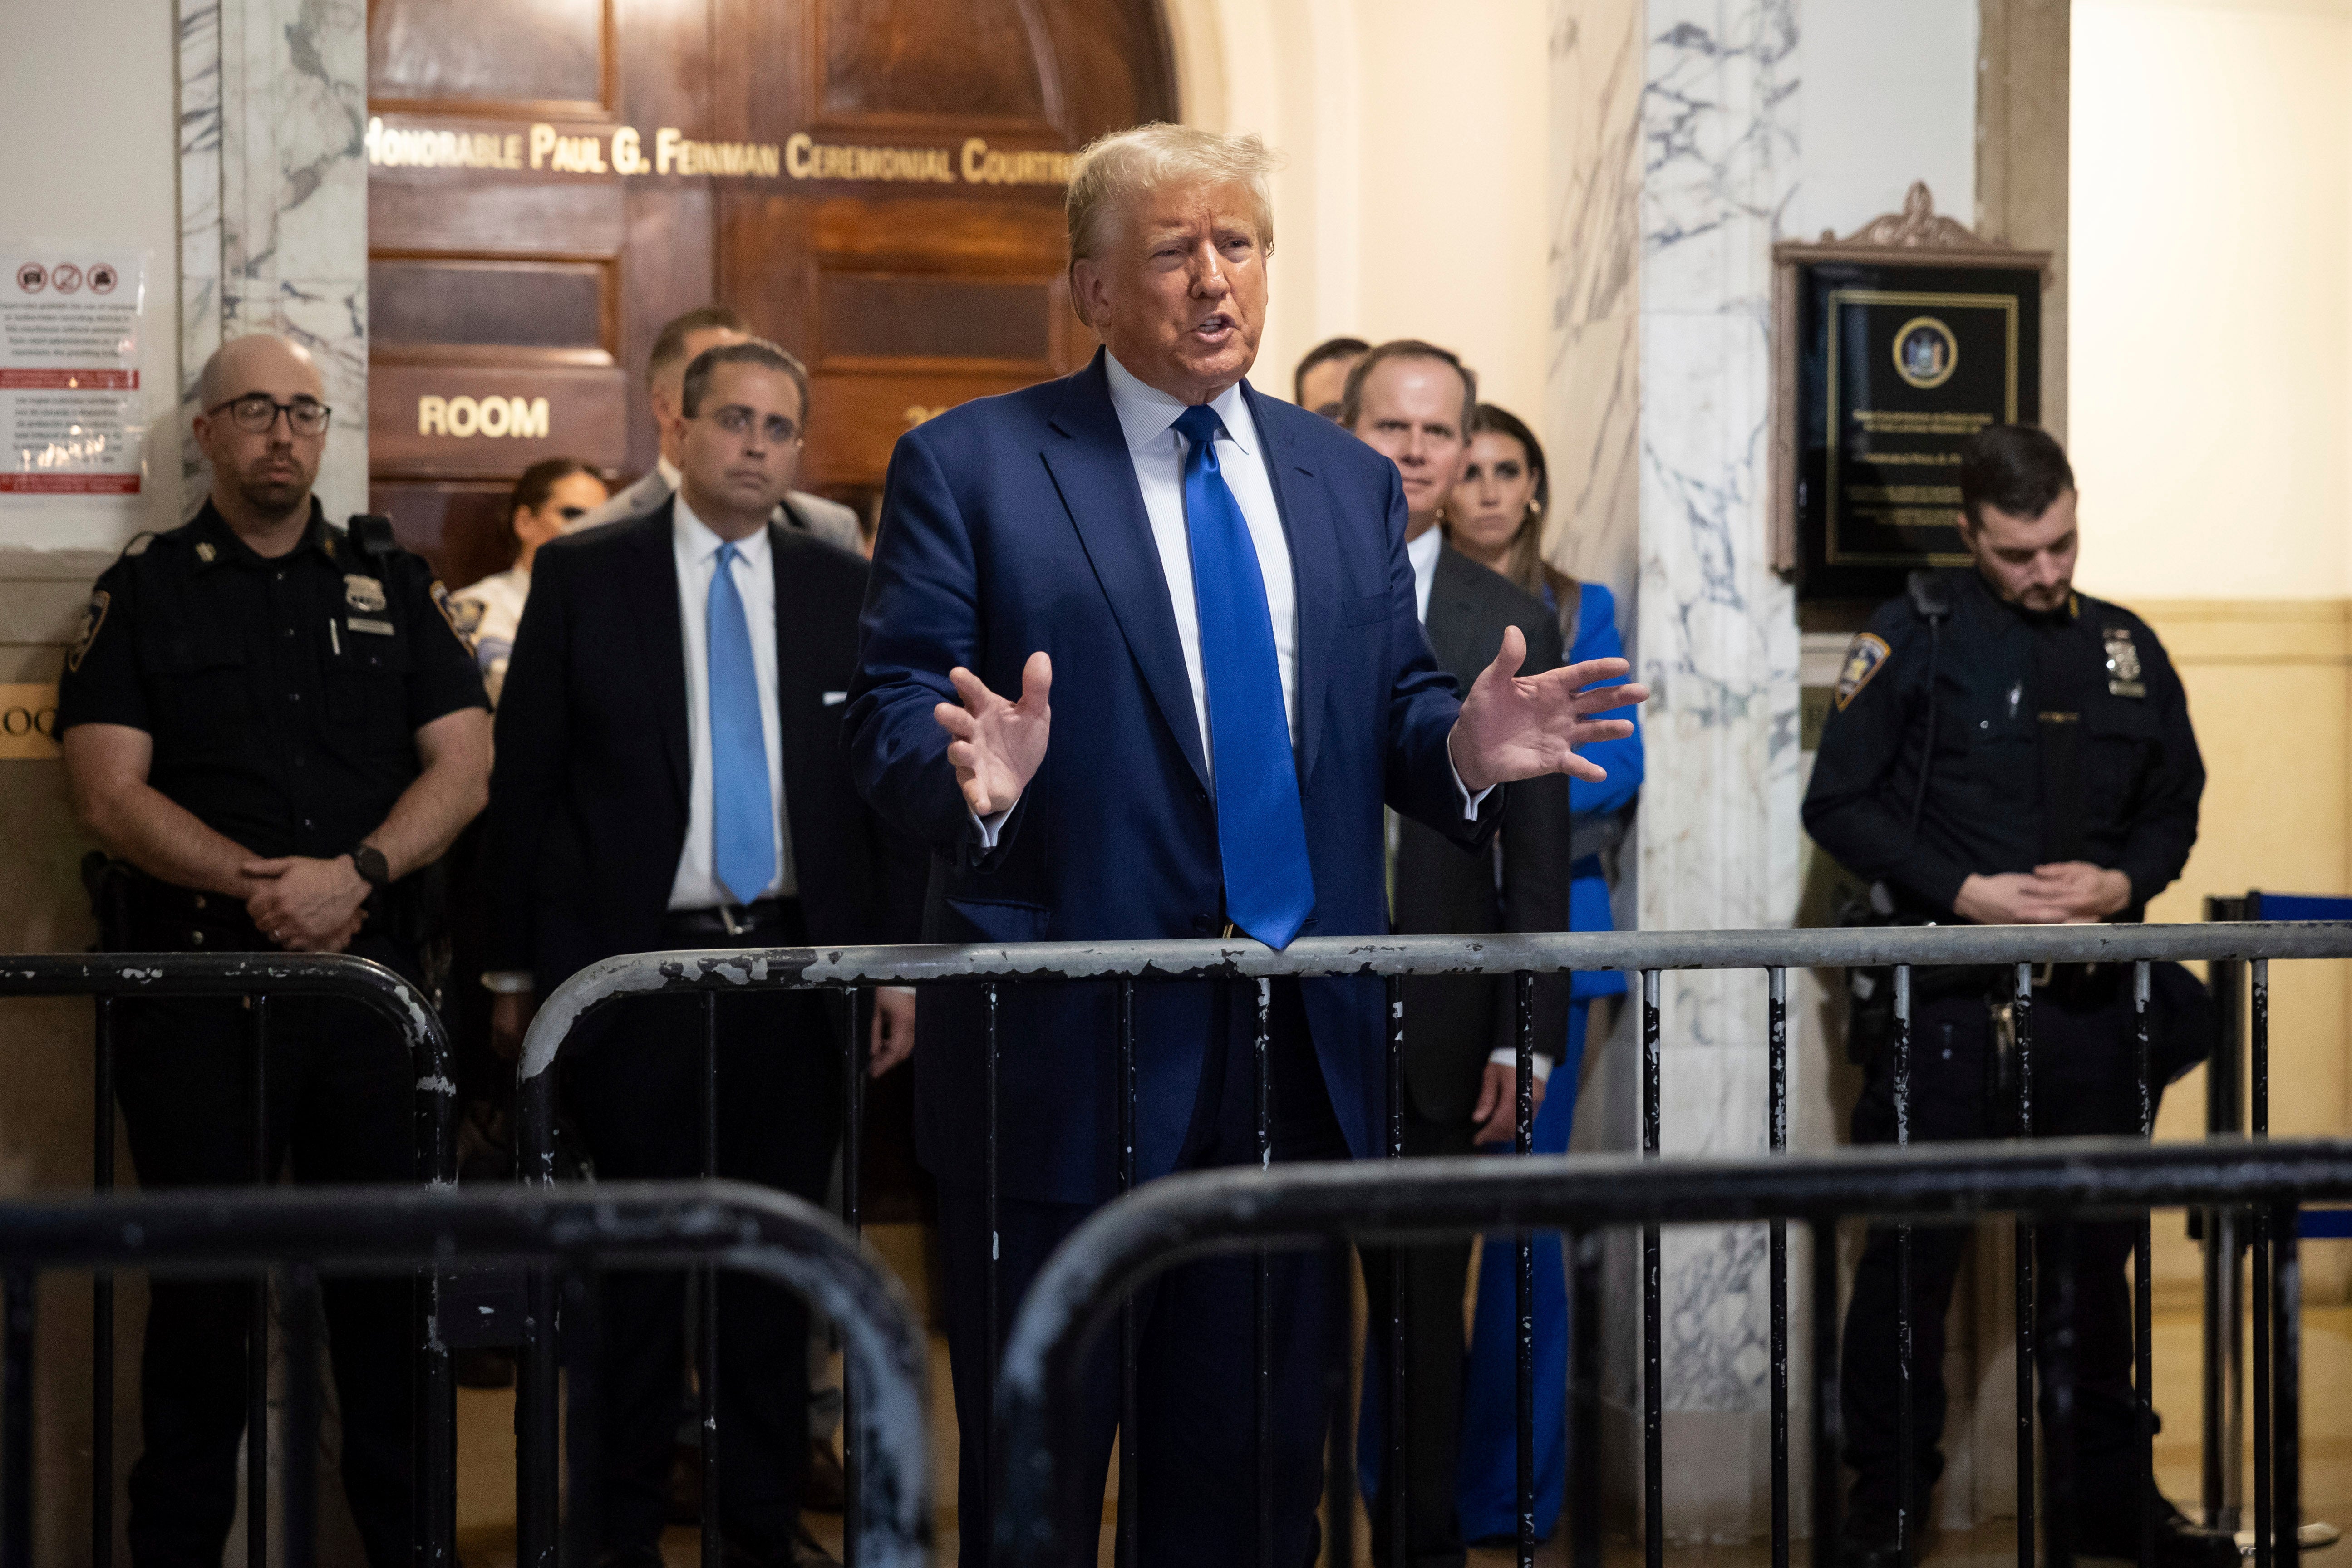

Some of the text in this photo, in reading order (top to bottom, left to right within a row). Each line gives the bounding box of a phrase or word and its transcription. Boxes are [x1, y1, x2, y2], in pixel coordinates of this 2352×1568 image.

[530, 123, 608, 174] PAUL
[611, 125, 651, 175] G.
[656, 127, 780, 176] FEINMAN
[418, 394, 550, 439] ROOM
